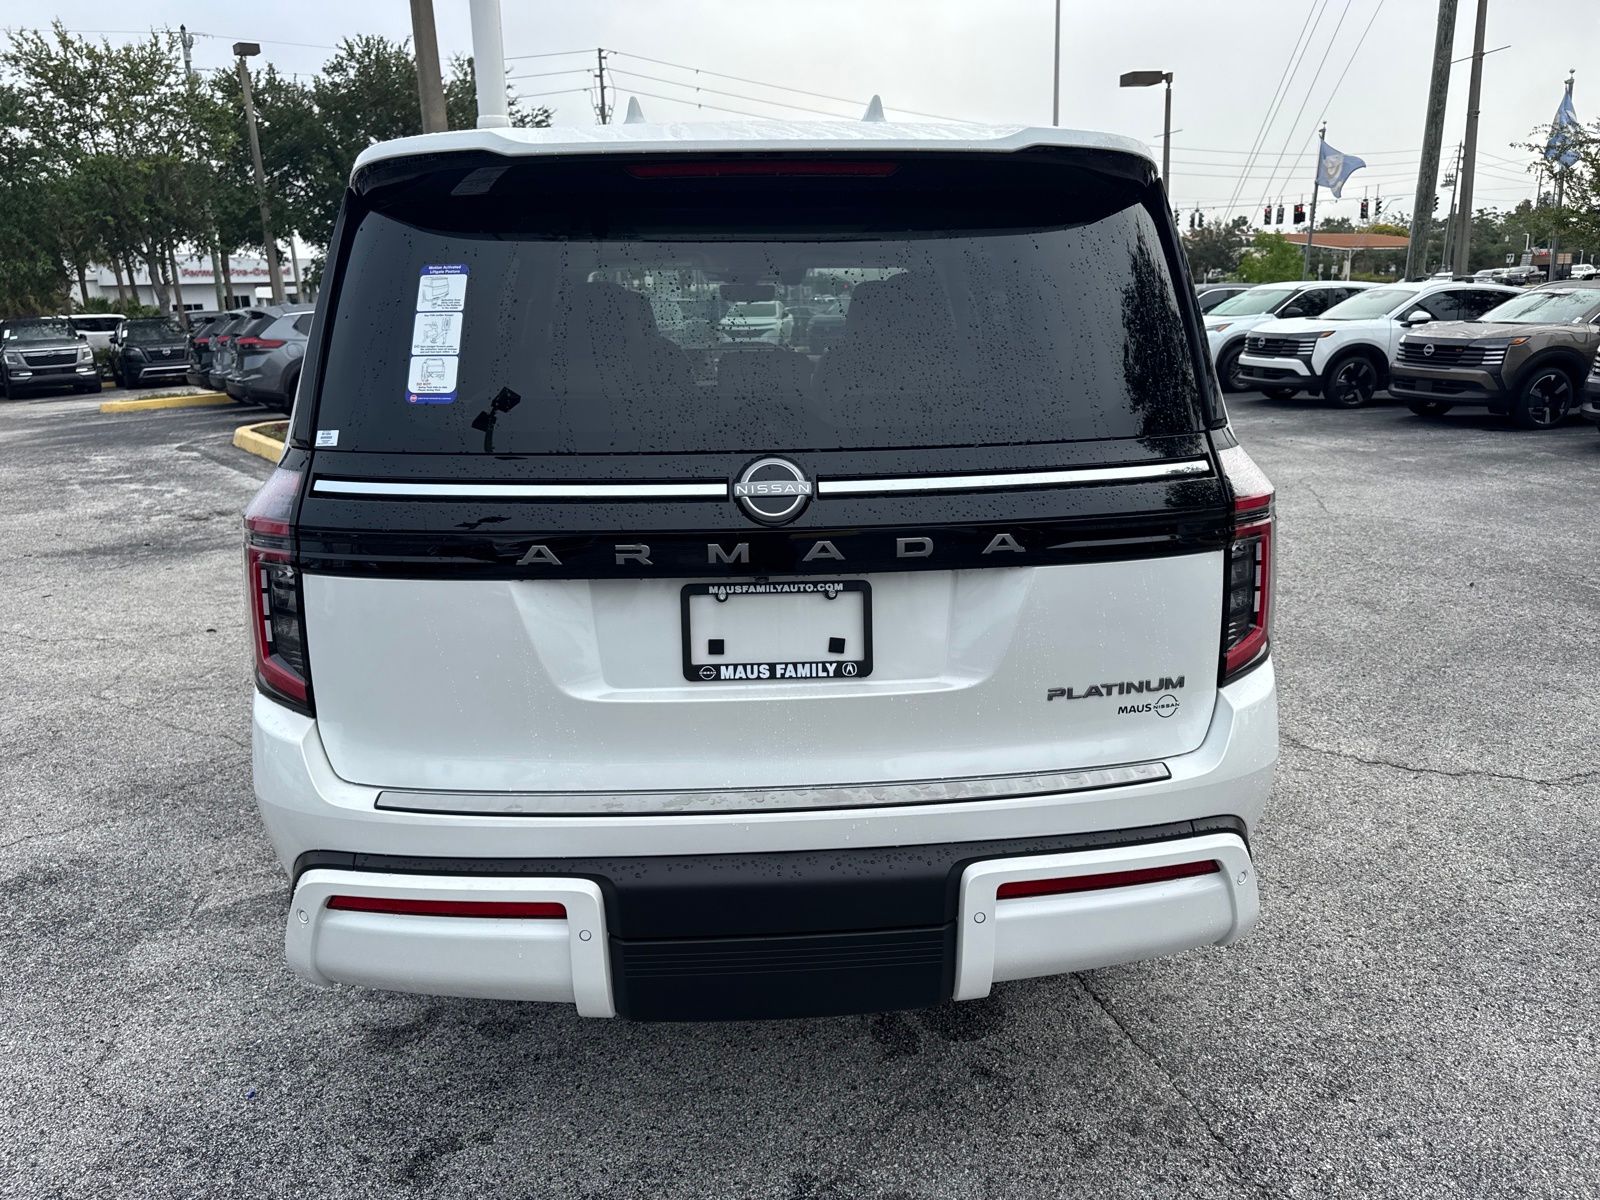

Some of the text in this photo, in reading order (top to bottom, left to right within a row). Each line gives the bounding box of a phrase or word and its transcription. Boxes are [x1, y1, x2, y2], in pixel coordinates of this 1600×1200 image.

[736, 484, 810, 495] NISSAN
[516, 533, 1026, 566] ARMADA
[708, 583, 843, 594] MAUSFAMILYAUTO.COM
[720, 662, 838, 680] MAUS FAMILY
[1047, 675, 1185, 701] PLATINUM
[1117, 702, 1180, 715] MAUS NISSAN
